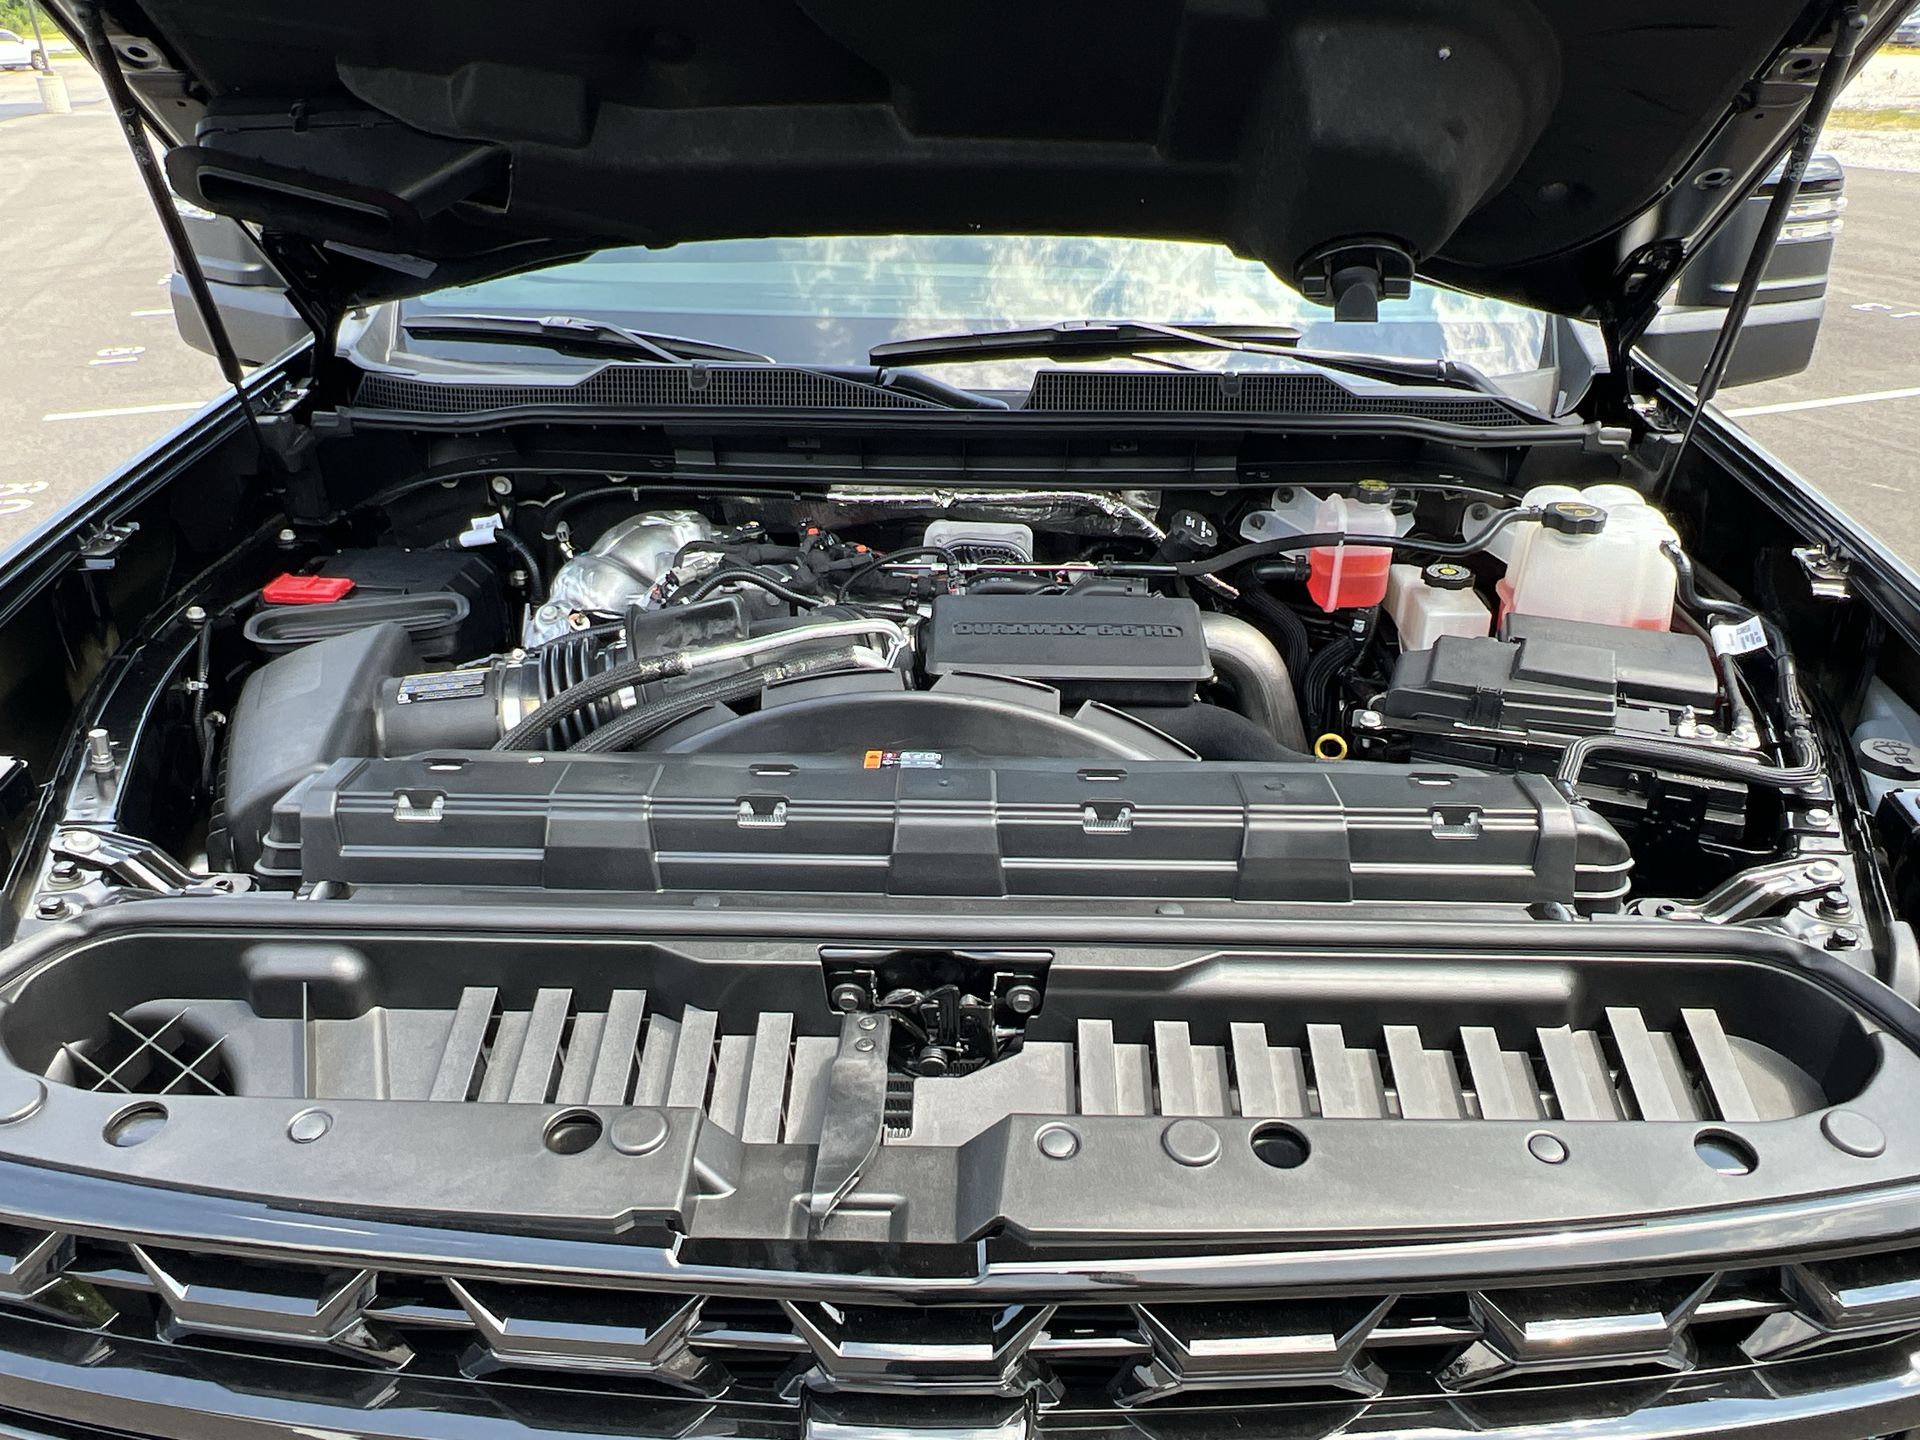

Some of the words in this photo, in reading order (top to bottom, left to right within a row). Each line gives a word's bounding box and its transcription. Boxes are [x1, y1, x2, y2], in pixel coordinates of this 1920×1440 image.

[953, 622, 1086, 636] DURAMAX
[1097, 623, 1138, 637] 6.6
[1143, 623, 1183, 638] HD
